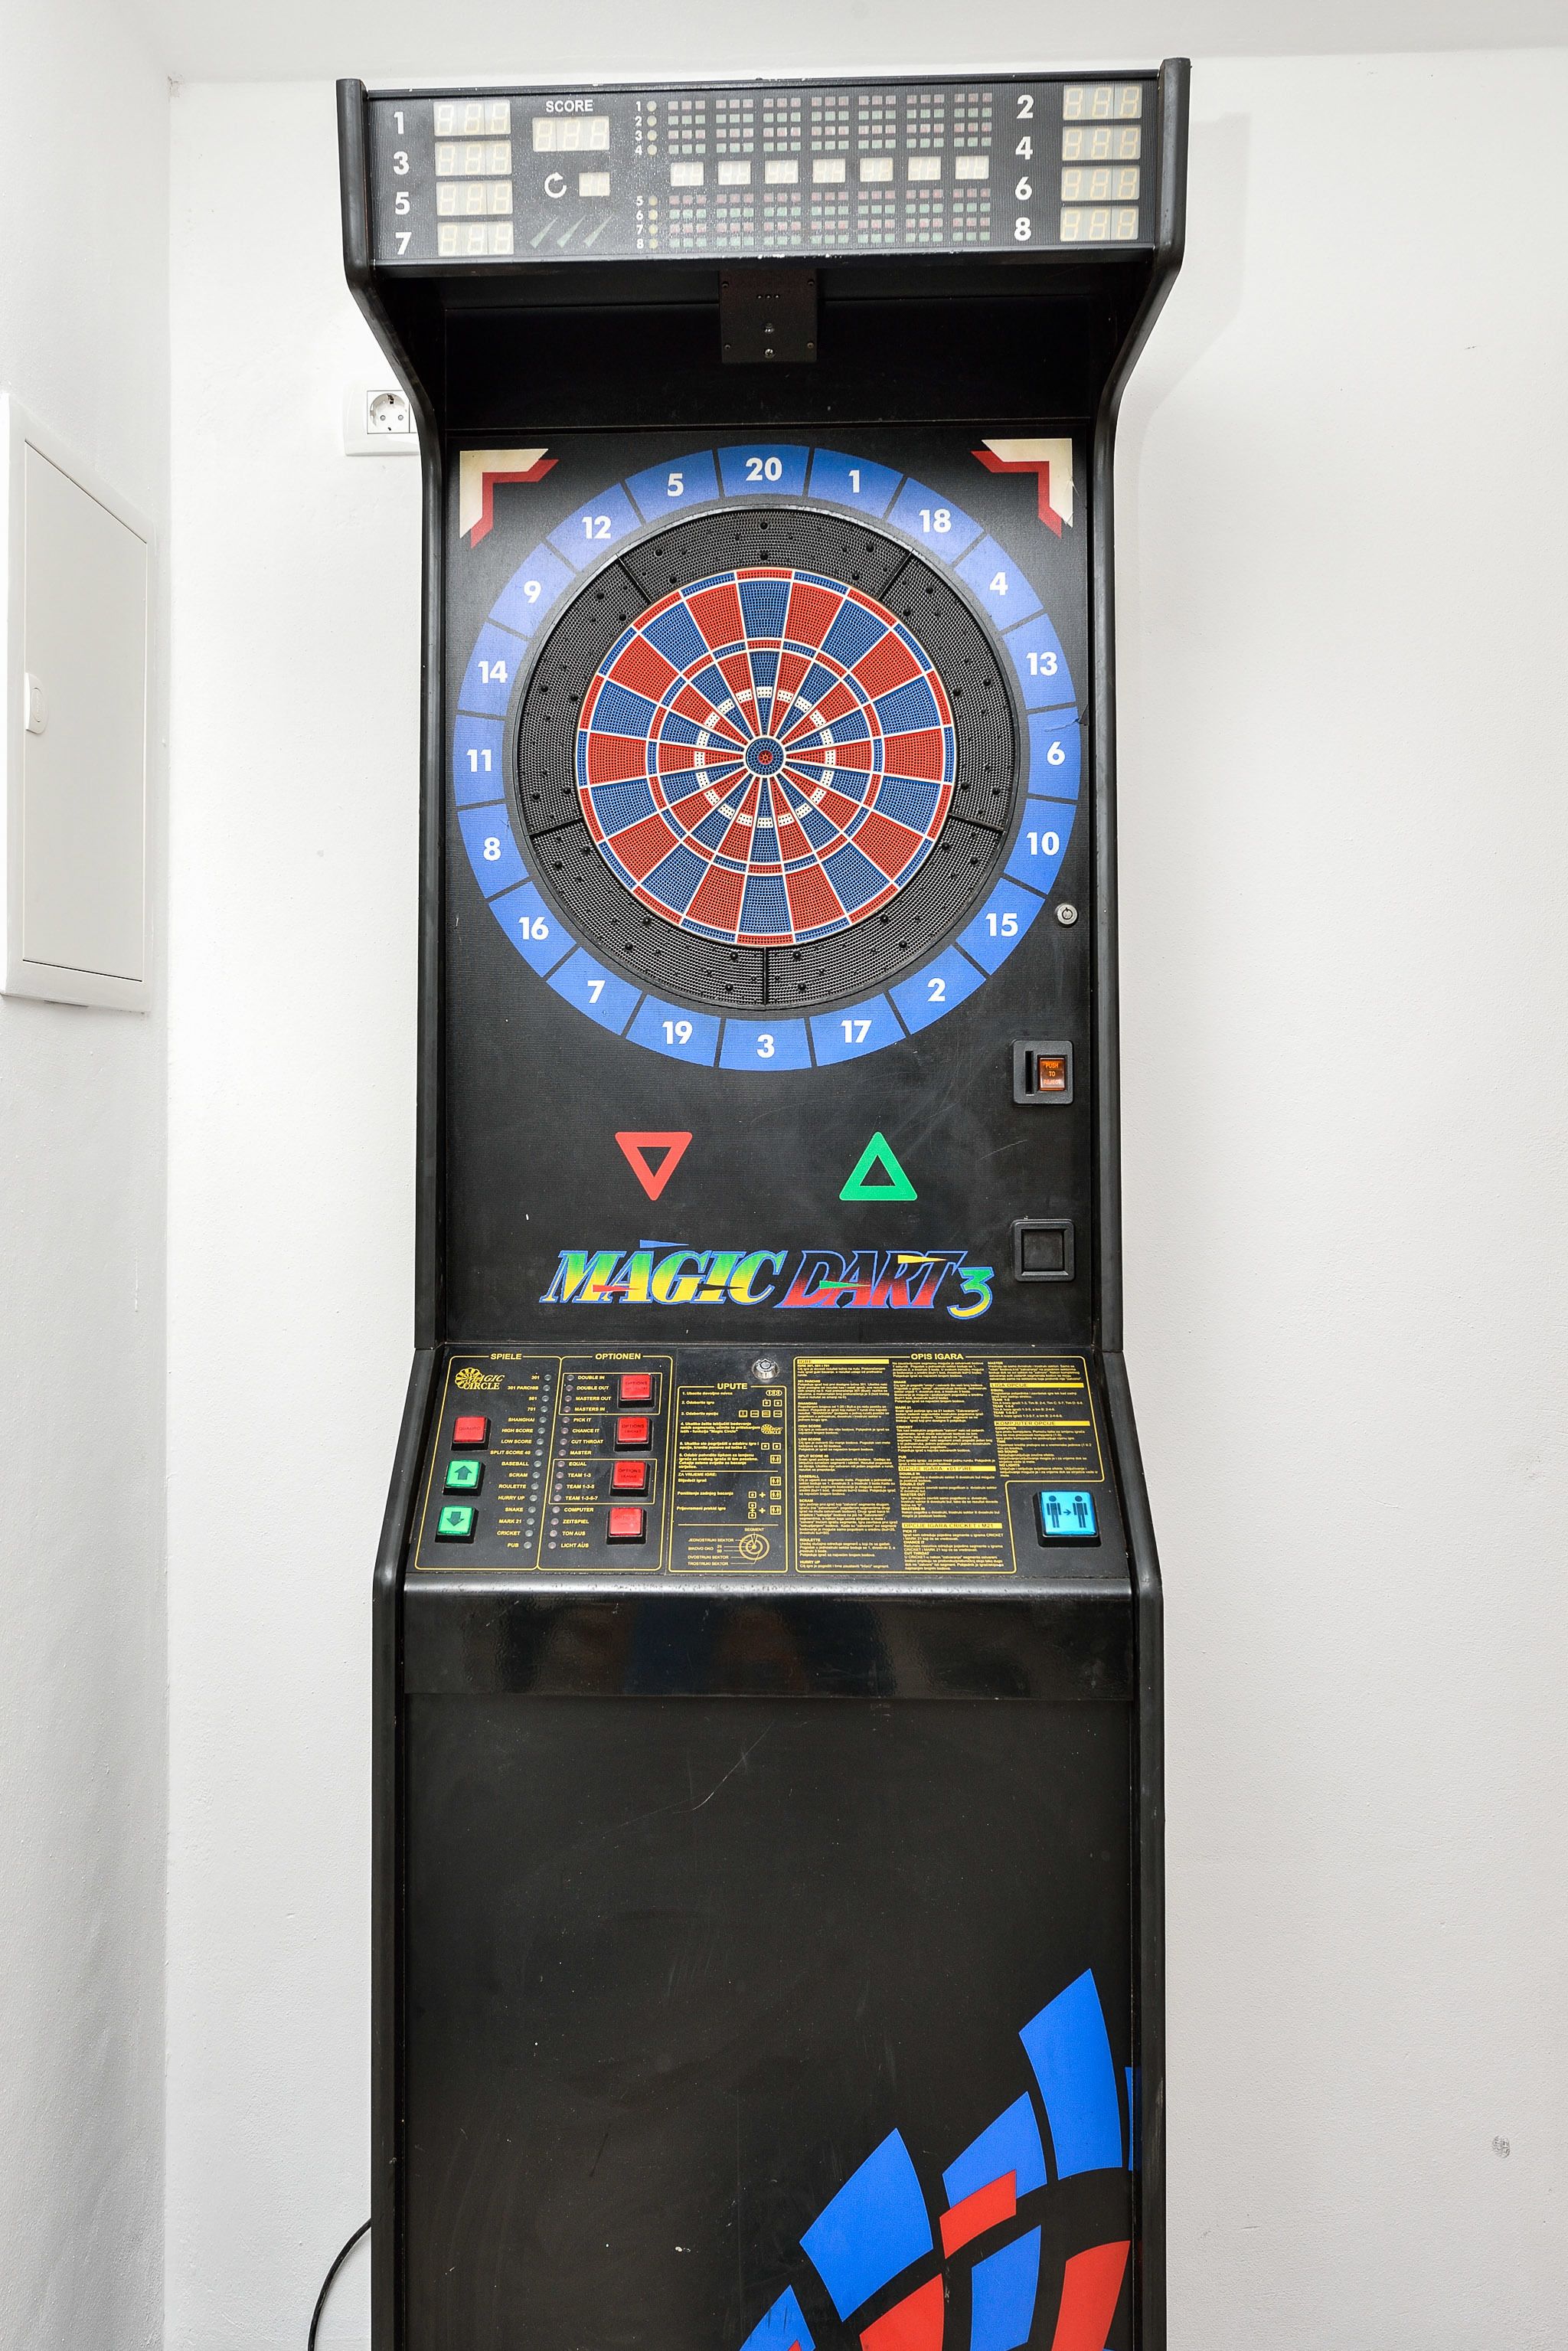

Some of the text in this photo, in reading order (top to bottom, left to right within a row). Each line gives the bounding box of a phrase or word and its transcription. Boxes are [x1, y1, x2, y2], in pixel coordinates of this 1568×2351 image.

[546, 100, 593, 113] SCORE
[636, 101, 642, 111] 1
[1017, 95, 1034, 119] 2
[394, 112, 403, 134] 1
[635, 116, 642, 126] 2
[635, 130, 642, 141] 3
[635, 145, 642, 155] 4
[1016, 136, 1033, 159] 4
[394, 152, 410, 175] 3
[1015, 177, 1032, 200] 6
[395, 191, 410, 214] 5
[635, 195, 643, 206] 5
[636, 210, 643, 220] 6
[636, 224, 643, 234] 7
[1014, 217, 1031, 240] 8
[396, 232, 412, 255] 7
[636, 238, 644, 249] 8
[746, 457, 782, 481] 20
[668, 473, 684, 496] 5
[849, 470, 859, 492] 1
[583, 516, 611, 539] 12
[919, 509, 951, 533] 18
[524, 580, 541, 603] 9
[990, 572, 1008, 595] 4
[478, 661, 508, 683] 14
[1027, 652, 1057, 675] 13
[467, 750, 491, 772] 11
[1047, 742, 1065, 765] 6
[484, 837, 501, 861] 8
[1027, 832, 1059, 855] 10
[519, 917, 549, 940] 16
[986, 914, 1018, 937] 15
[588, 980, 605, 1003] 7
[928, 978, 945, 1002] 2
[662, 1021, 692, 1044] 19
[841, 1020, 871, 1042] 17
[757, 1035, 774, 1058] 3
[539, 1250, 994, 1319] MAGIC DART 3
